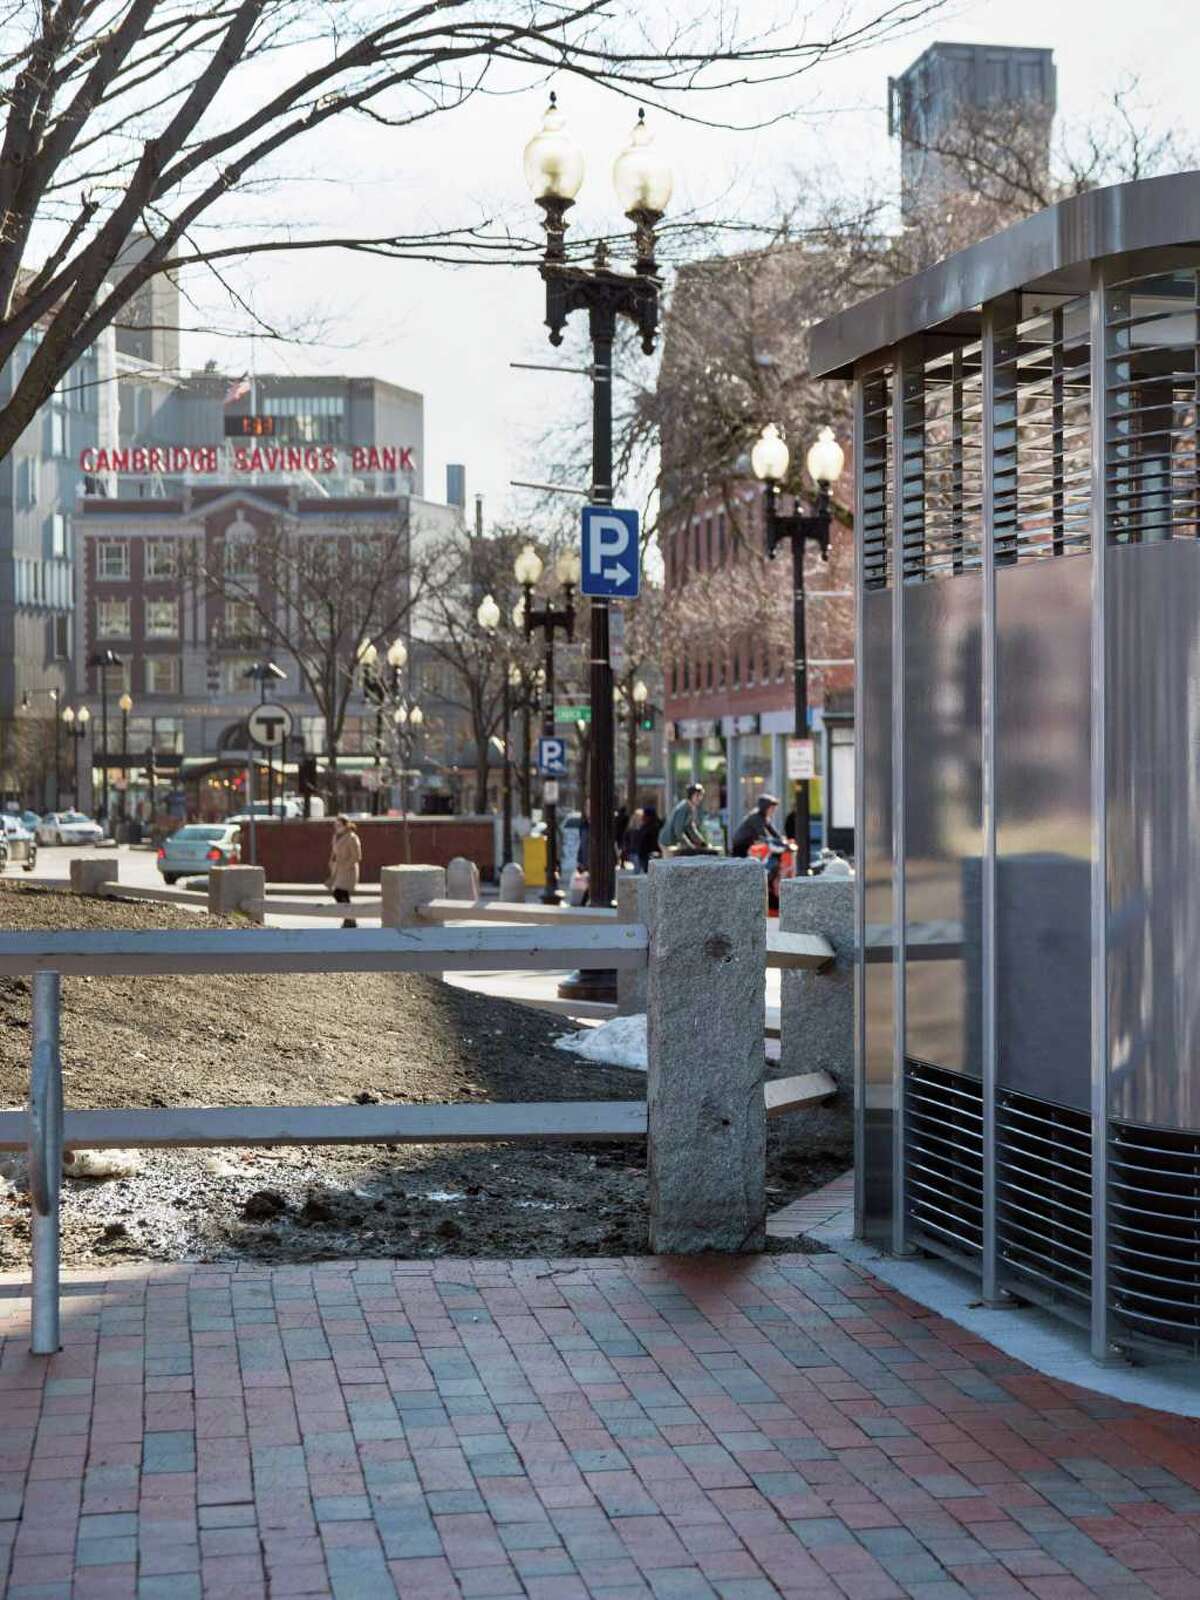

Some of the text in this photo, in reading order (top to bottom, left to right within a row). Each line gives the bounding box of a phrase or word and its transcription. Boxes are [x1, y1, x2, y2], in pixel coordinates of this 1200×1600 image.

[79, 447, 414, 474] CAMBRIDGE SAVINGS BANK
[590, 515, 629, 574] P
[256, 717, 285, 740] T
[541, 741, 562, 768] P
